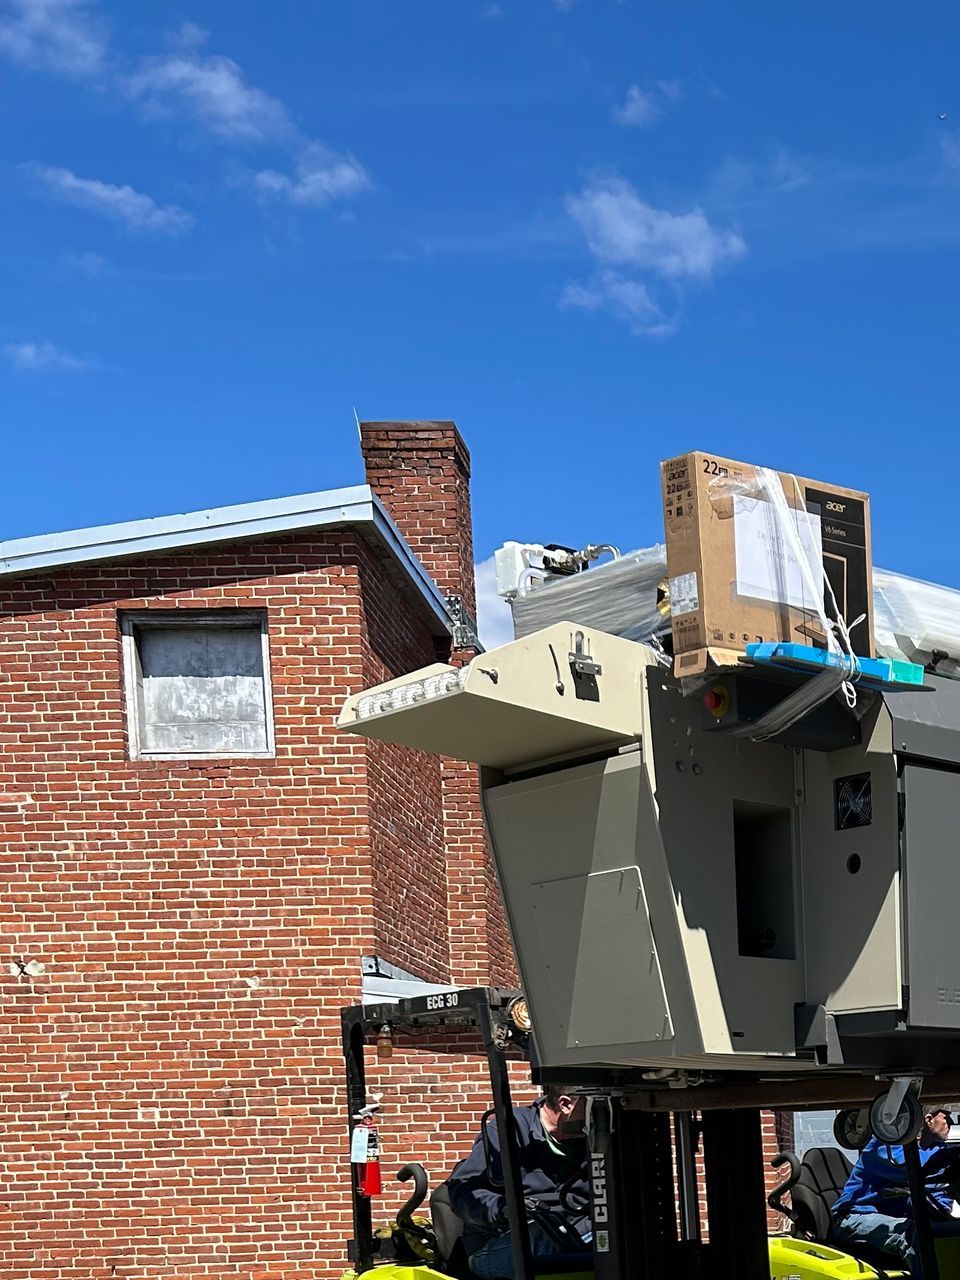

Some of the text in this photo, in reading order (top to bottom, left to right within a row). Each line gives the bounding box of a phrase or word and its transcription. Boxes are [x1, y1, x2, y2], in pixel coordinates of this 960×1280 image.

[703, 459, 719, 476] 22
[668, 468, 688, 481] acer
[667, 484, 677, 495] 22
[826, 501, 847, 512] acer
[832, 526, 846, 537] Series
[426, 993, 458, 1010] ECG 30
